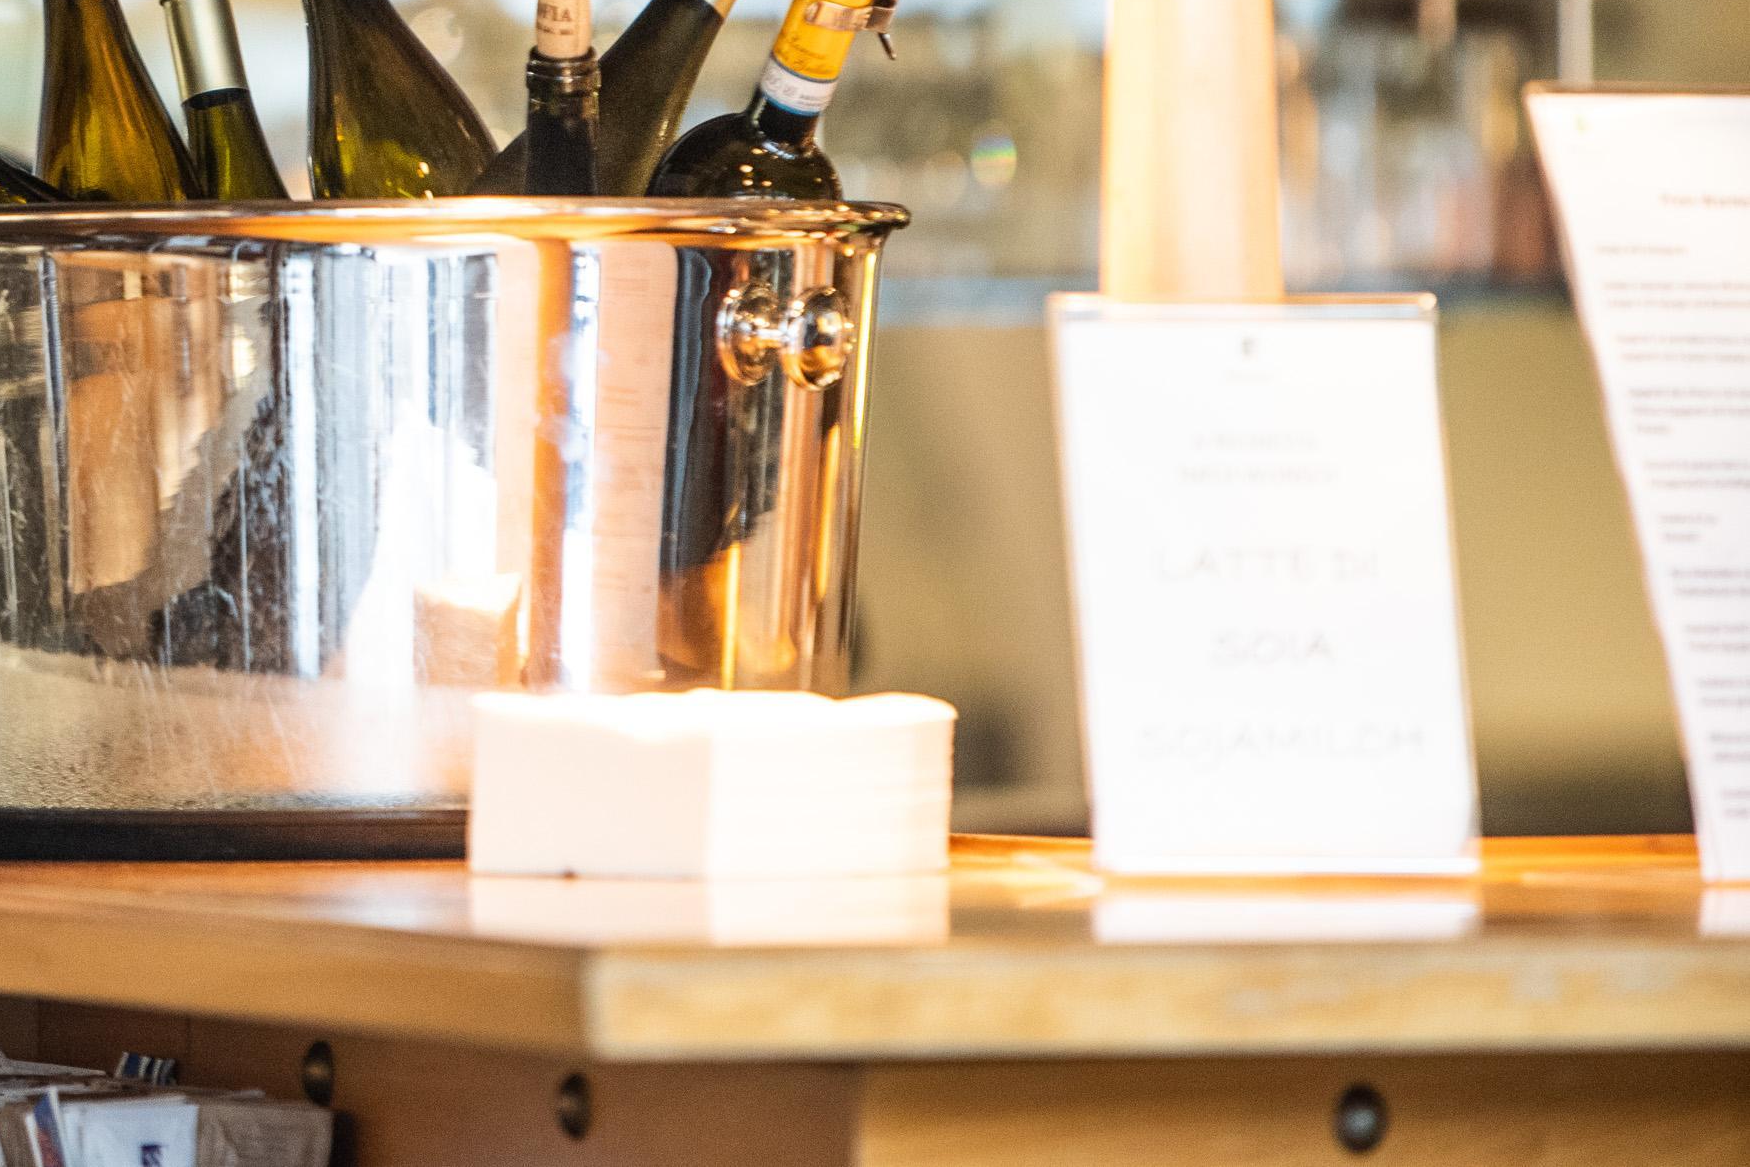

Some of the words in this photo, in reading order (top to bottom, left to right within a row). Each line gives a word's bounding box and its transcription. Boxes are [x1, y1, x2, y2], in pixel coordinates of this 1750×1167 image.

[1152, 547, 1317, 584] LATTE
[1330, 547, 1381, 584] DI
[1210, 629, 1337, 670] SOIA
